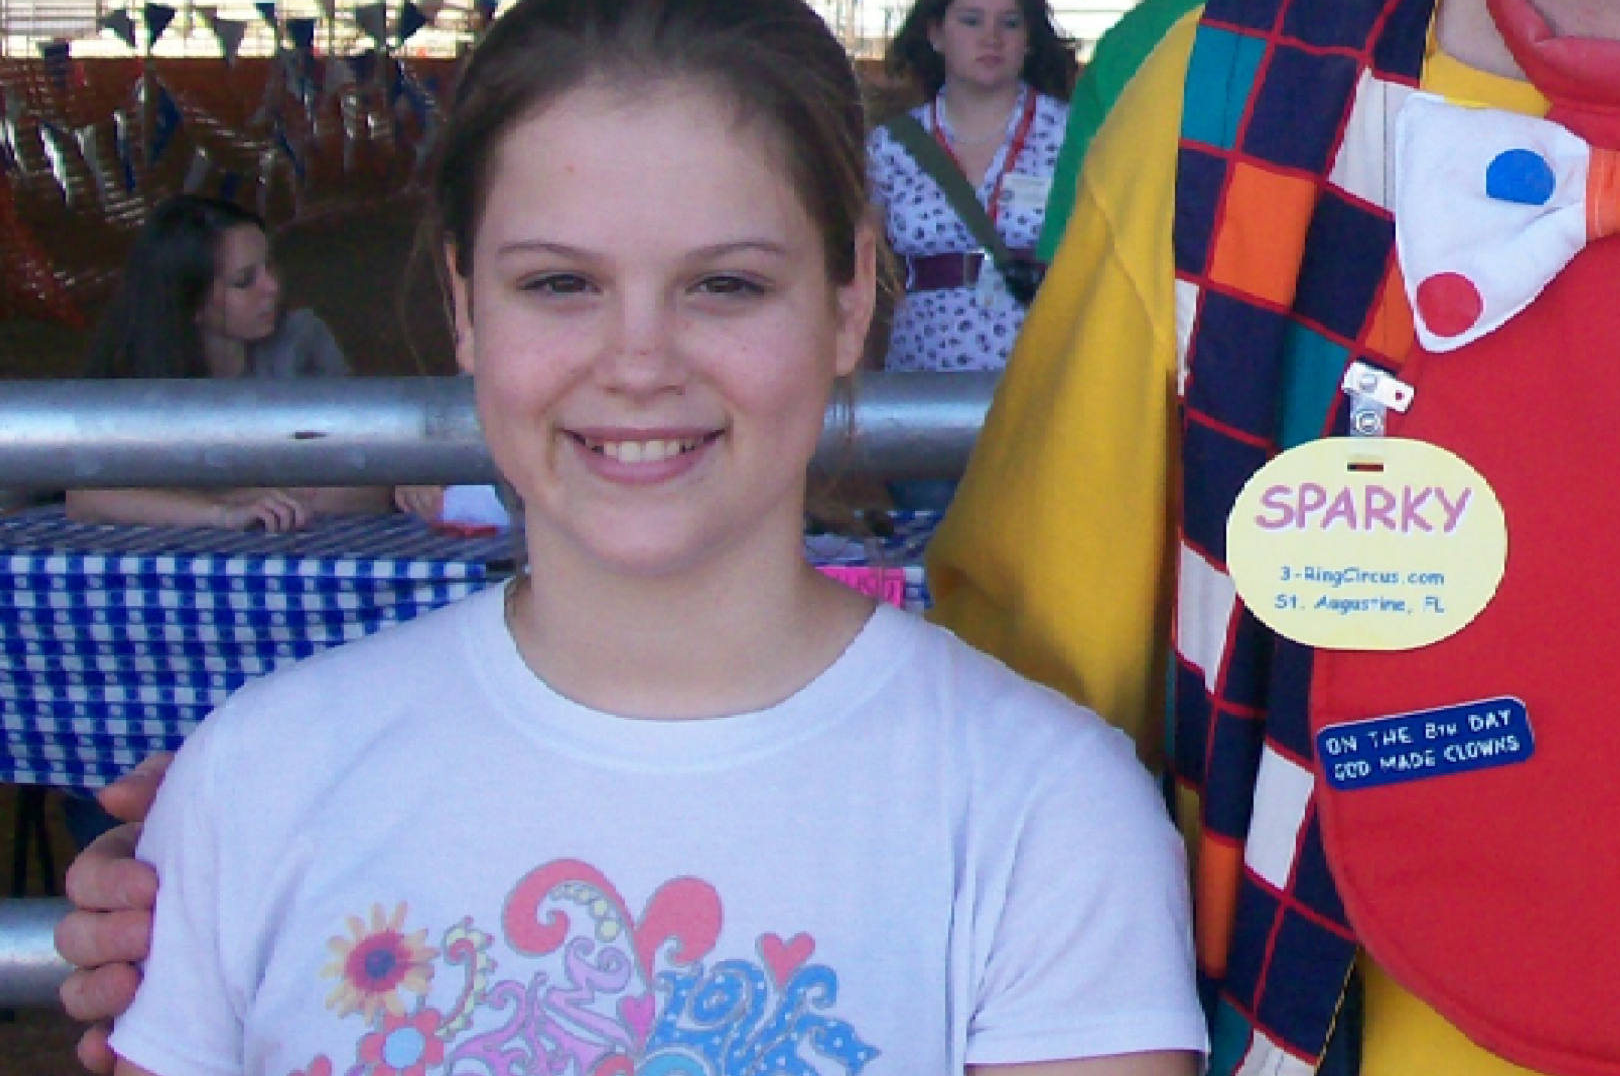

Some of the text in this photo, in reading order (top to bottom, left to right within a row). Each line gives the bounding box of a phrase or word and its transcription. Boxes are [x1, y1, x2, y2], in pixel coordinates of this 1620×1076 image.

[1254, 482, 1472, 533] SPARKY
[1280, 565, 1445, 589] 3-RingCircus.com
[1274, 593, 1445, 615] St. Augustine, FL
[1325, 735, 1357, 756] ON
[1367, 726, 1413, 748] THE
[1467, 709, 1512, 732] DAY
[1334, 735, 1521, 781] GOD MADE CLOWNS
